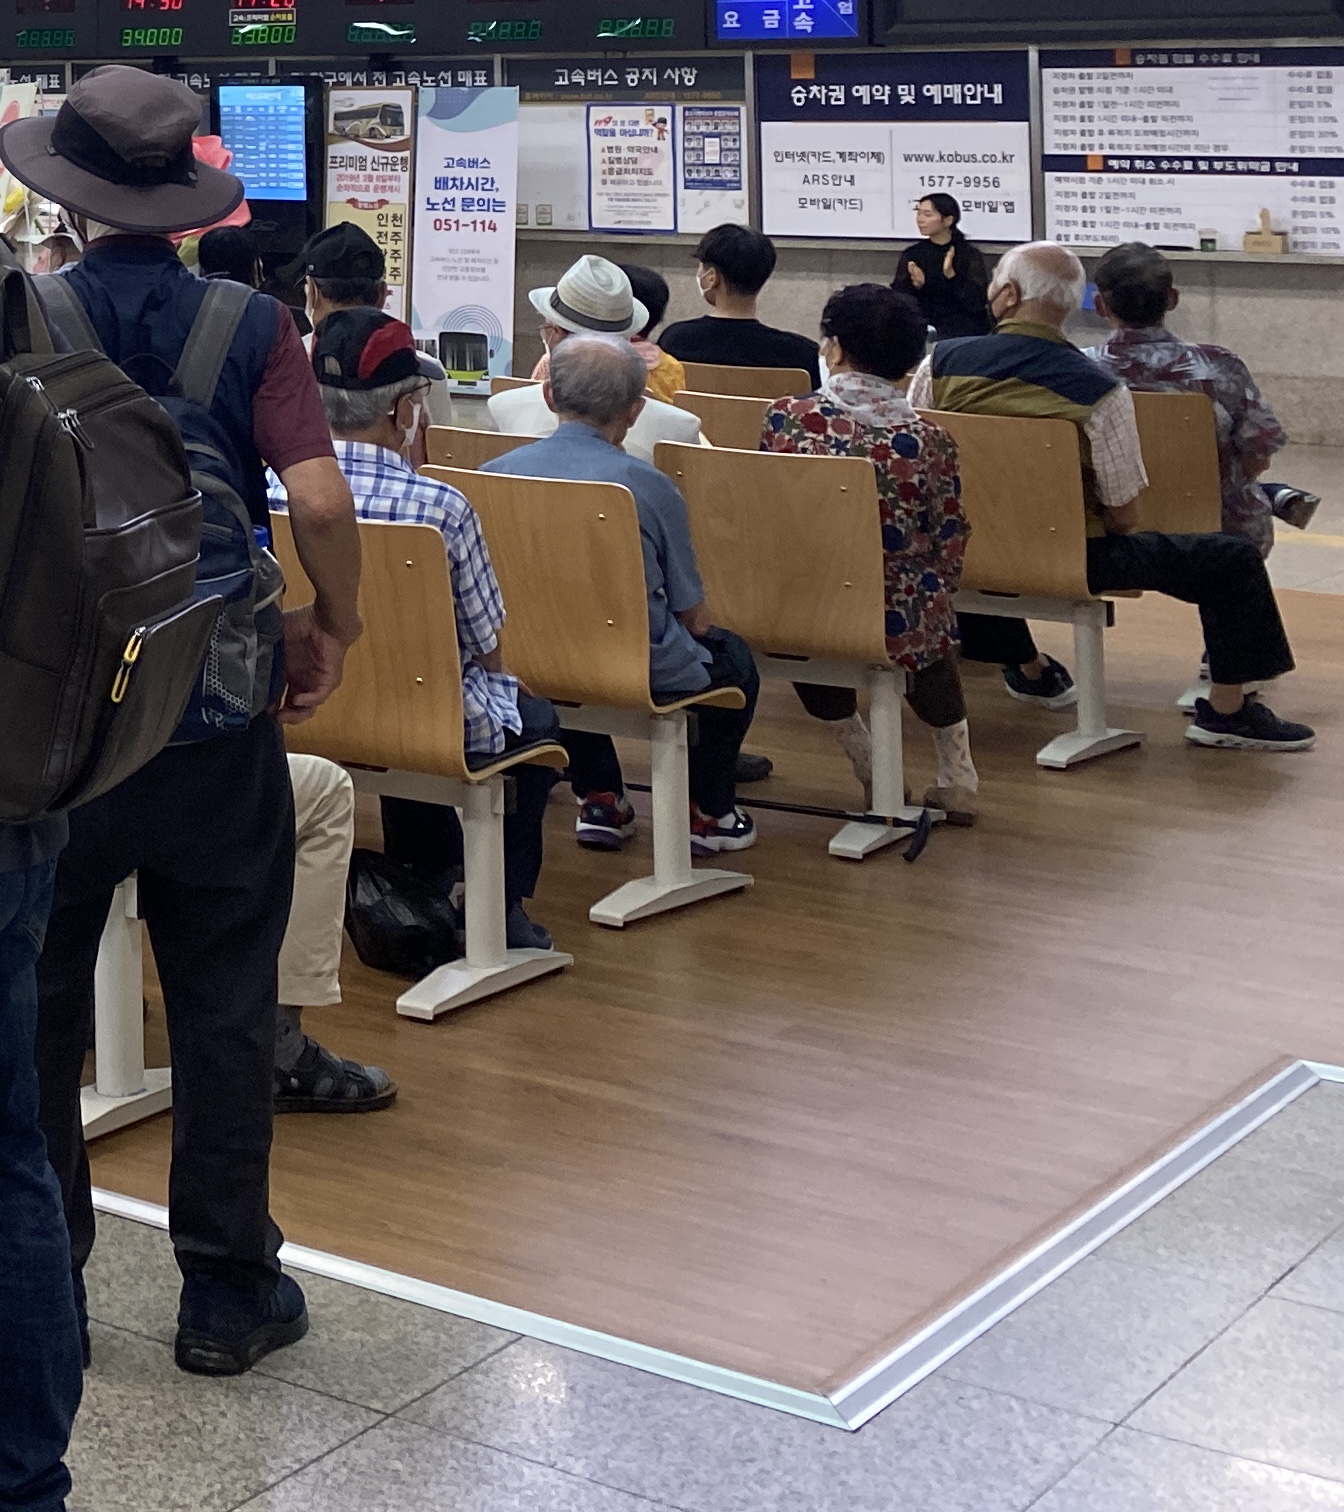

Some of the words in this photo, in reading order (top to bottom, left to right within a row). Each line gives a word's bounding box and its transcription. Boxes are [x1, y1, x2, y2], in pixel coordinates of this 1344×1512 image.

[373, 71, 386, 86] 전
[393, 71, 451, 87] 고속노선
[458, 71, 488, 86] 매표
[555, 68, 618, 86] 고속버스
[625, 67, 657, 86] 공지
[663, 67, 698, 86] 사항
[791, 85, 845, 106] 승차권
[852, 84, 890, 105] 예약
[897, 84, 916, 105] 및
[923, 83, 1003, 105] 예매안내
[329, 155, 368, 172] 프리미엄
[371, 154, 409, 172] 신규운행
[443, 157, 491, 169] 고속버스
[903, 151, 1015, 164] www.kobus.co.kr
[1108, 159, 1131, 171] 예약
[1134, 159, 1156, 171] 취소
[1160, 160, 1194, 171] 수수료
[1274, 161, 1299, 173] 안내
[434, 176, 500, 193] 배차시간,
[802, 174, 855, 187] ARS안내
[919, 175, 1000, 188] 1577-9956
[425, 197, 456, 212] 노선
[461, 197, 506, 213] 문의는
[798, 197, 863, 212] 모바일(카드)
[1003, 200, 1015, 214] 앱
[376, 213, 403, 228] 인천
[433, 219, 497, 232] 051-114
[376, 230, 403, 245] 전주
